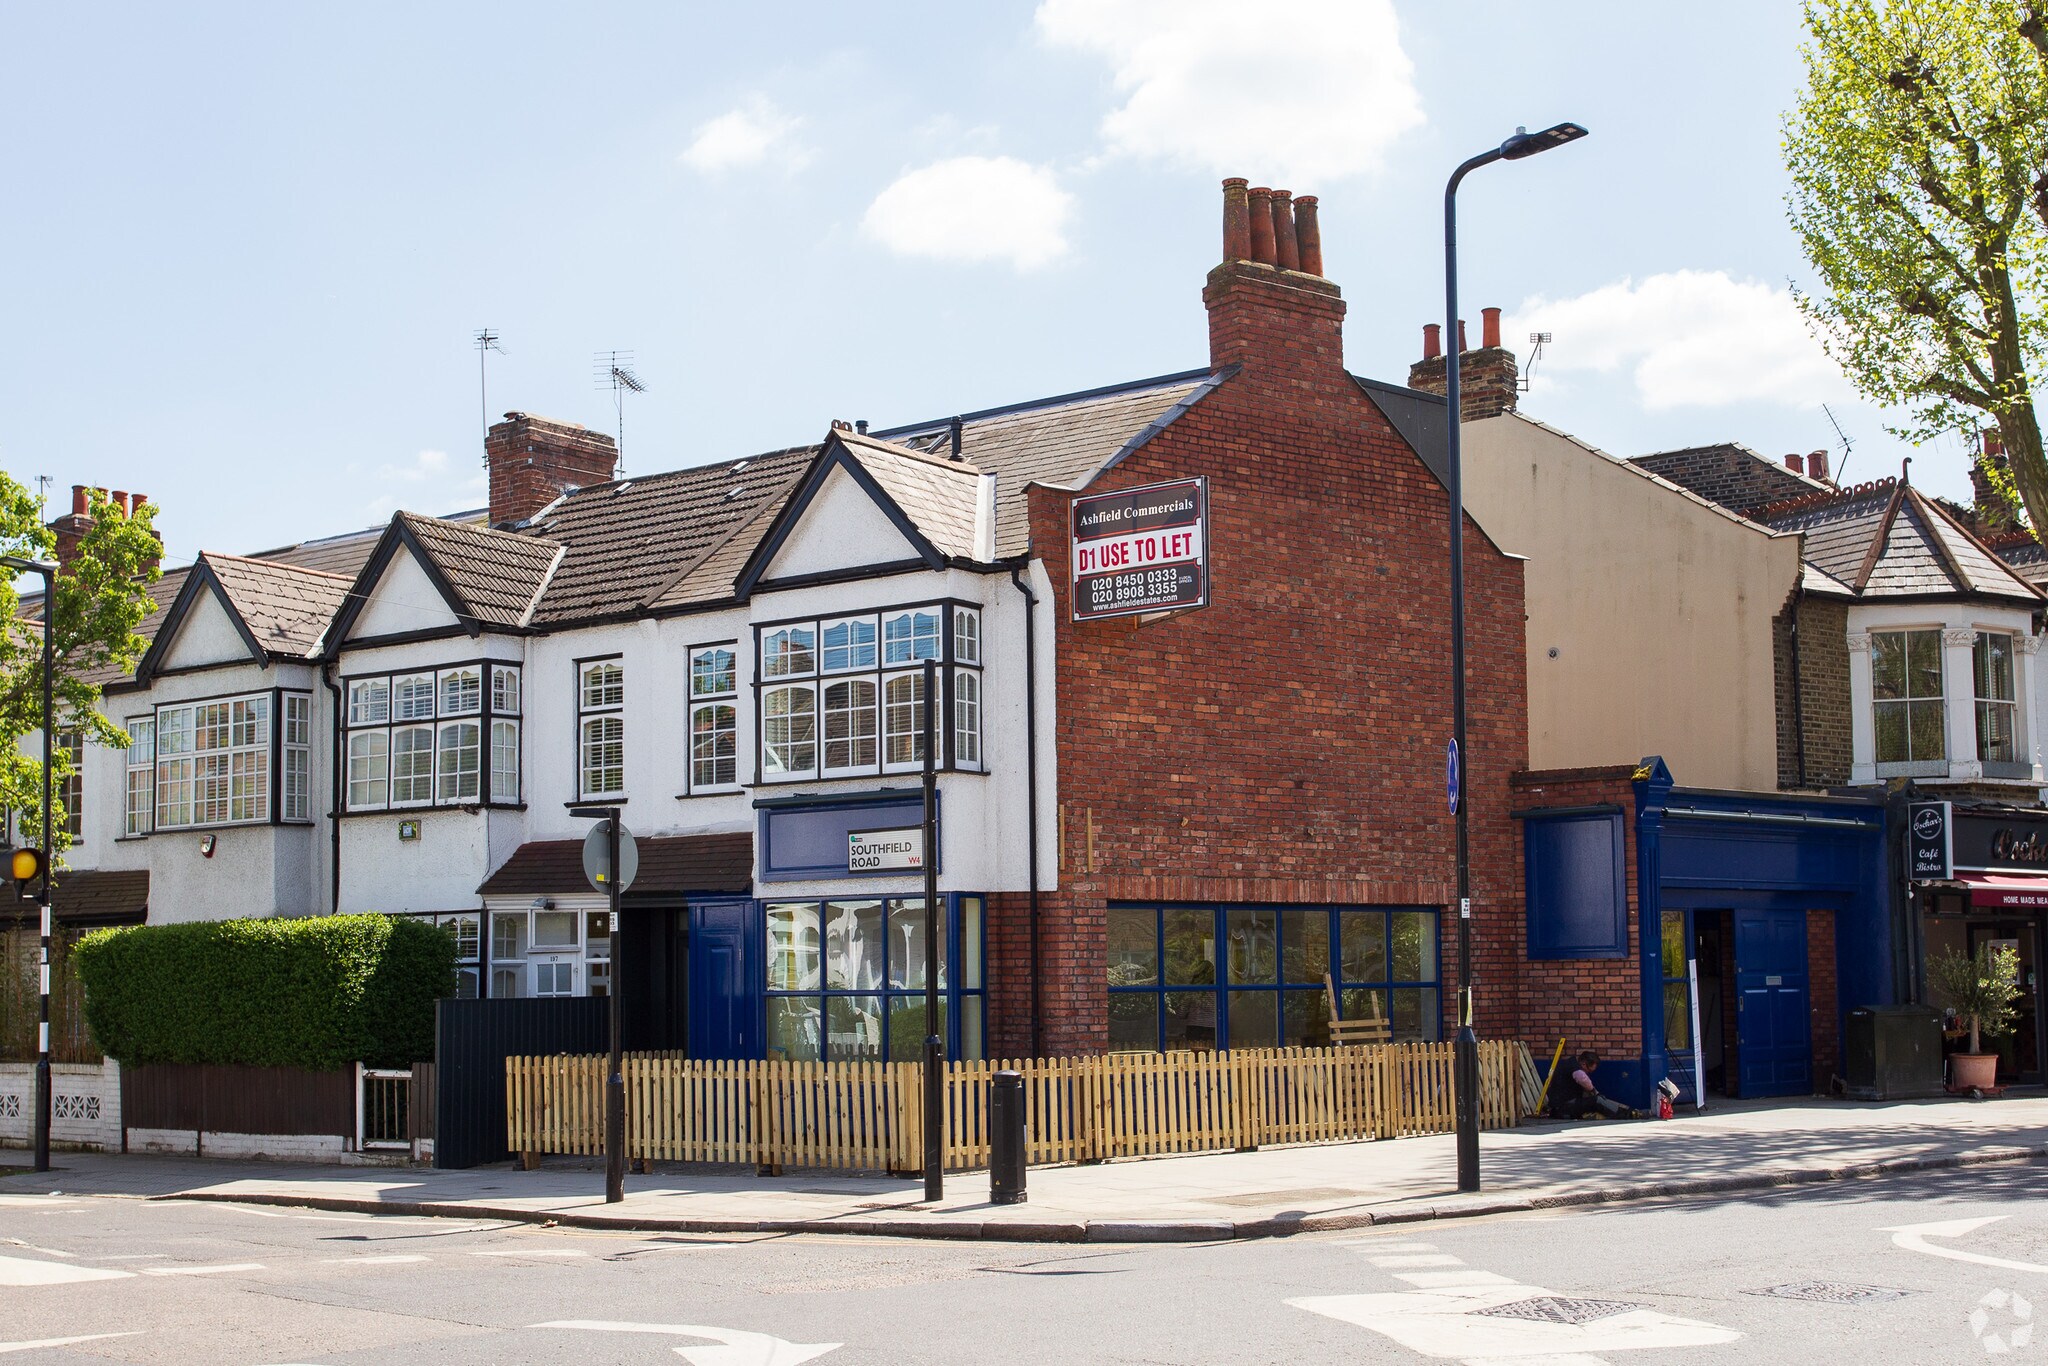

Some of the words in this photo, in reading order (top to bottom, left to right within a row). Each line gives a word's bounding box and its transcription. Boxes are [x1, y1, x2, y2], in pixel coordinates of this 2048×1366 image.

[1080, 509, 1121, 526] Ashfield
[1124, 499, 1193, 519] Commercials
[1079, 547, 1095, 571] D1
[1101, 541, 1129, 567] USE
[1135, 537, 1156, 562] TO
[1162, 532, 1192, 559] LET
[1092, 578, 1112, 591] 020
[1116, 573, 1144, 588] 8450
[1147, 568, 1177, 583] 0333
[1092, 591, 1113, 603] 020
[1116, 586, 1144, 600] 8908
[1148, 581, 1177, 596] 3355
[1092, 594, 1178, 611] www.ashfieldestates.com
[851, 842, 912, 856] SOUTHFIELD
[1919, 848, 1938, 860] Café
[851, 856, 880, 868] ROAD
[908, 856, 920, 864] W4
[1916, 861, 1942, 872] Bistro
[2003, 895, 2019, 904] HOME
[2020, 896, 2035, 904] MADE
[2036, 896, 2048, 905] MEA
